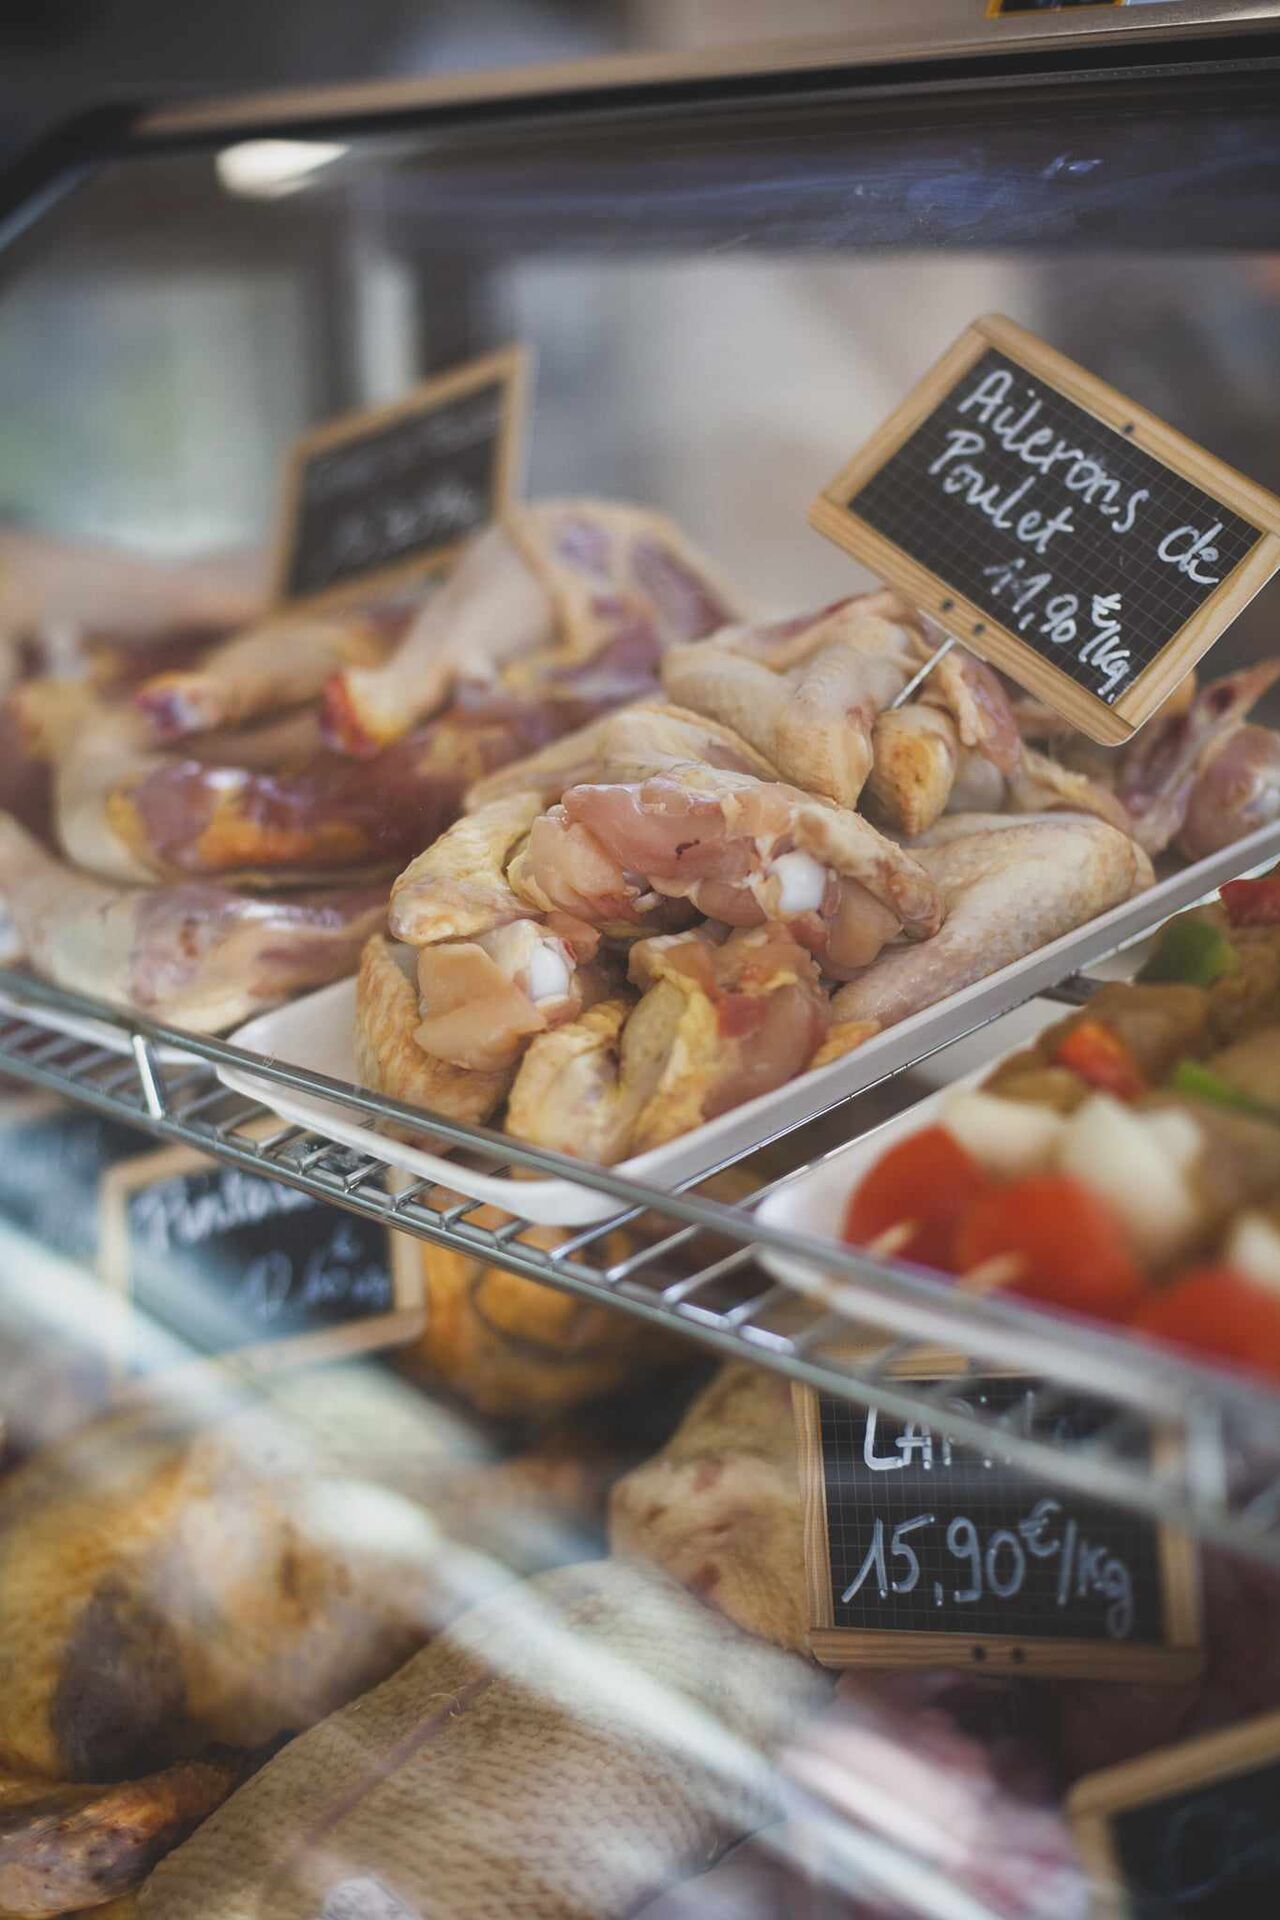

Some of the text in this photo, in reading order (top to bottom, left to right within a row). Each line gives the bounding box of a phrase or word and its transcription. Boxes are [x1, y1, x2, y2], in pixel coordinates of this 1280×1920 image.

[927, 429, 1075, 554] Poulet
[958, 369, 1220, 585] Ailerons de
